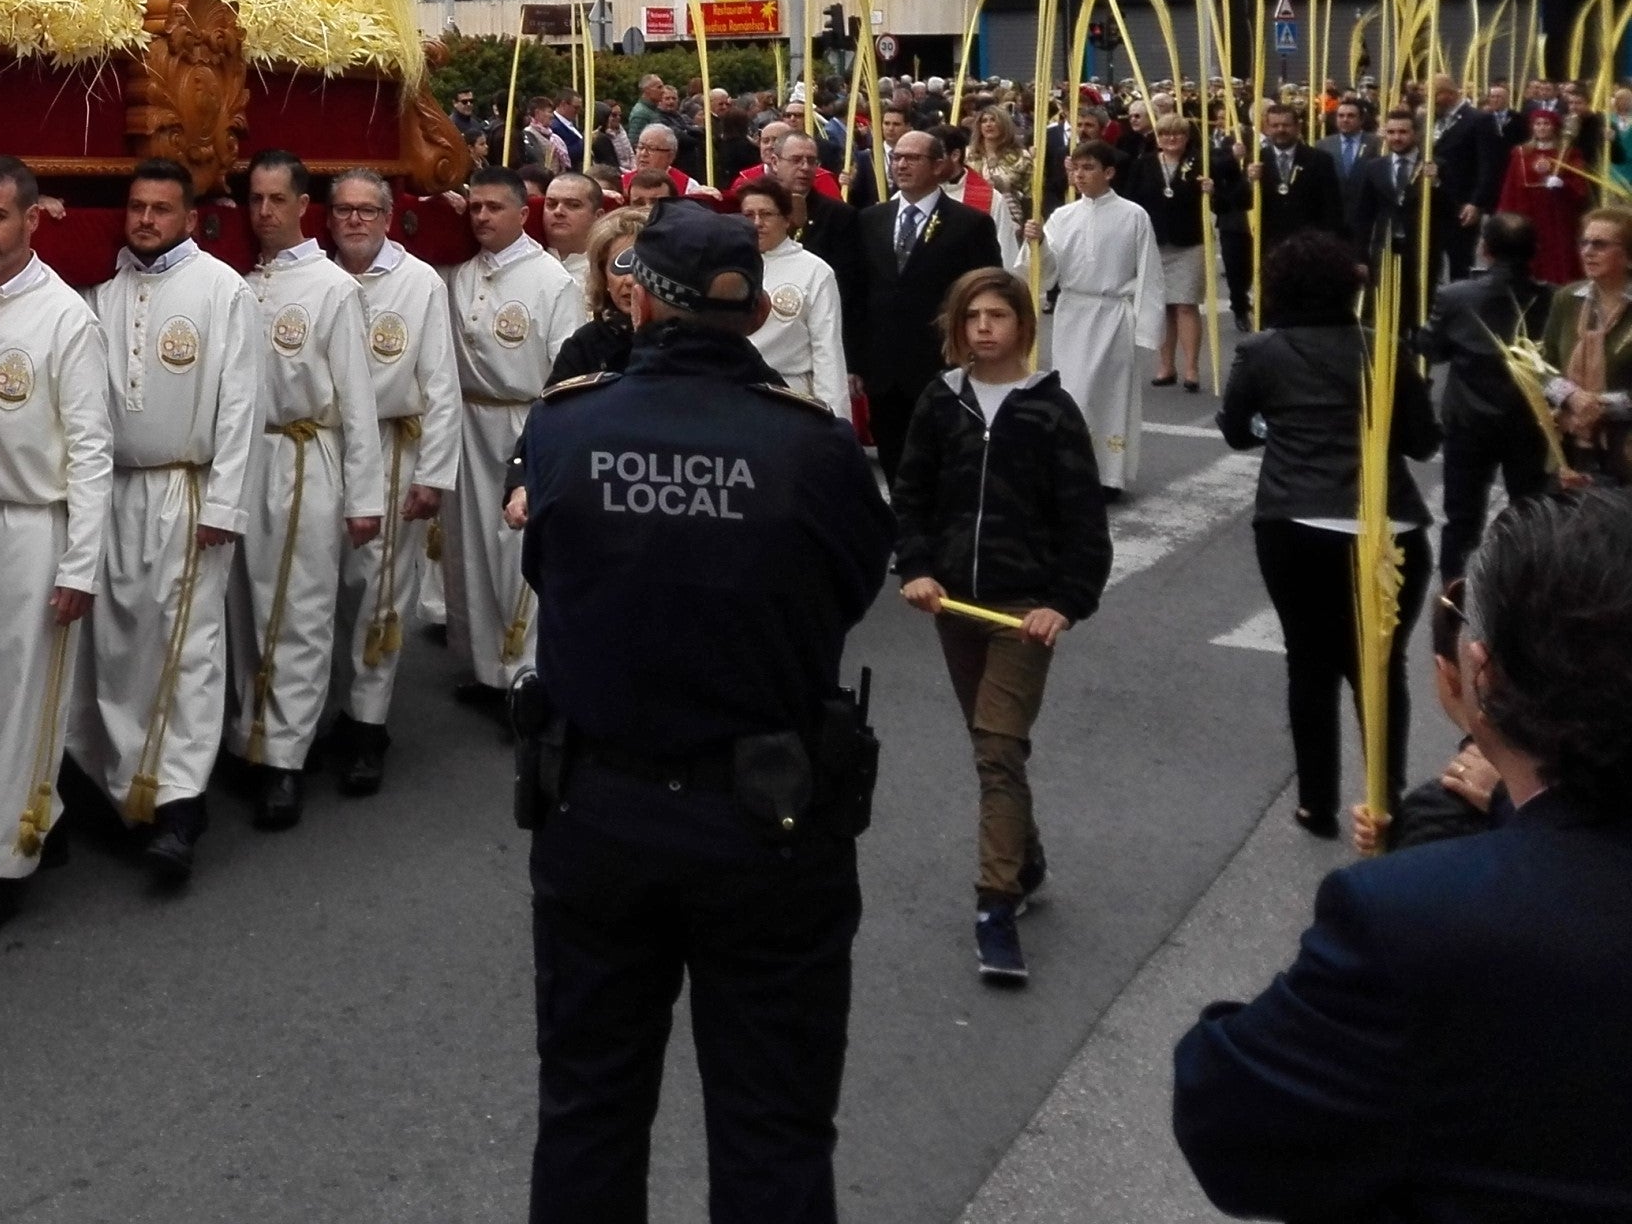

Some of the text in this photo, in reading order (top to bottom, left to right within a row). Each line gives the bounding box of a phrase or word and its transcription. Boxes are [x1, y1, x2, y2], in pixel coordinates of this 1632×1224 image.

[881, 42, 894, 51] 30
[591, 451, 755, 489] POLICIA
[603, 482, 744, 520] LOCAL
